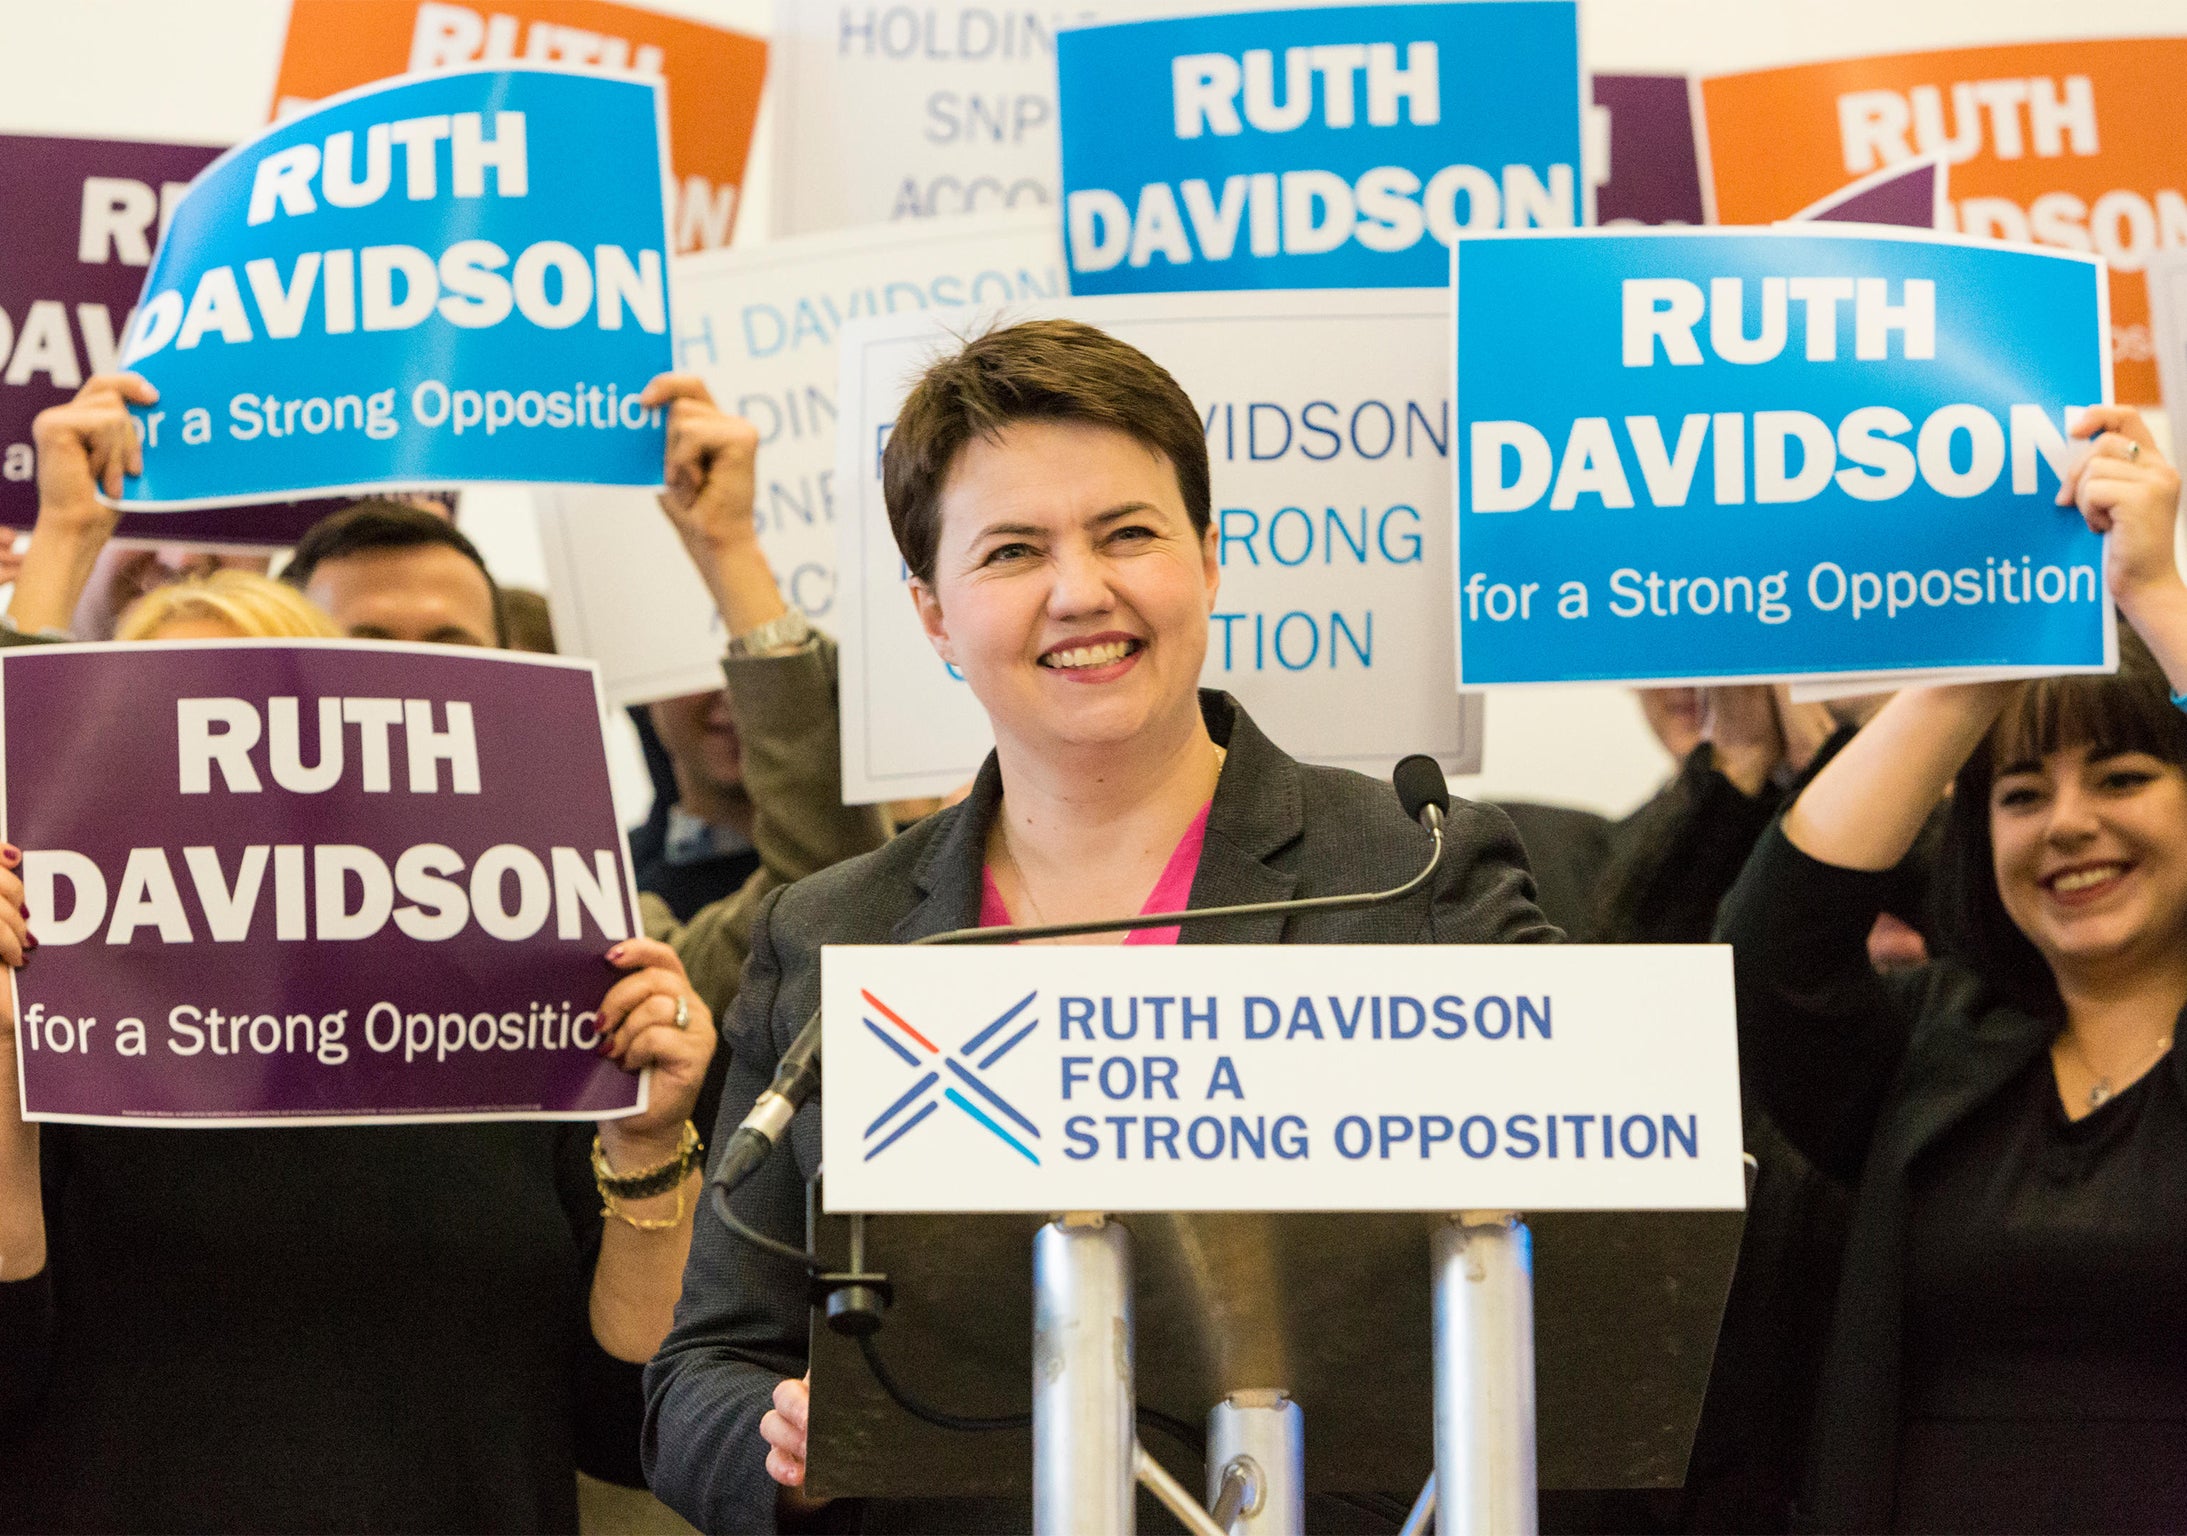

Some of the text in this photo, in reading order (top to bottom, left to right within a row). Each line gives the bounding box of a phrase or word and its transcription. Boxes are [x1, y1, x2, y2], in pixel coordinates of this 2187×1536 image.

[838, 5, 1056, 60] HOLDIN
[925, 90, 1051, 145] SNP
[1173, 42, 1440, 139] RUTH
[1836, 76, 2100, 174] RUTH
[247, 110, 528, 226] RUTH
[78, 176, 190, 266] R
[1068, 163, 1576, 272] DAVIDSON
[121, 240, 668, 366] DAVIDSON
[1622, 278, 1936, 367] RUTH
[182, 408, 211, 445] a
[229, 388, 399, 440] Strong
[1470, 404, 2083, 514] DAVIDSON
[1465, 556, 2096, 625] for a Strong Opposition
[176, 696, 482, 794] RUTH
[22, 844, 629, 946] DAVIDSON
[24, 1004, 96, 1055] for
[115, 1016, 147, 1056] a
[167, 1003, 349, 1066] Strong
[1058, 995, 1554, 1041] RUTH DAVIDSON
[1060, 1055, 1246, 1100] FOR A
[1063, 1114, 1700, 1161] STRONG OPPOSITION
